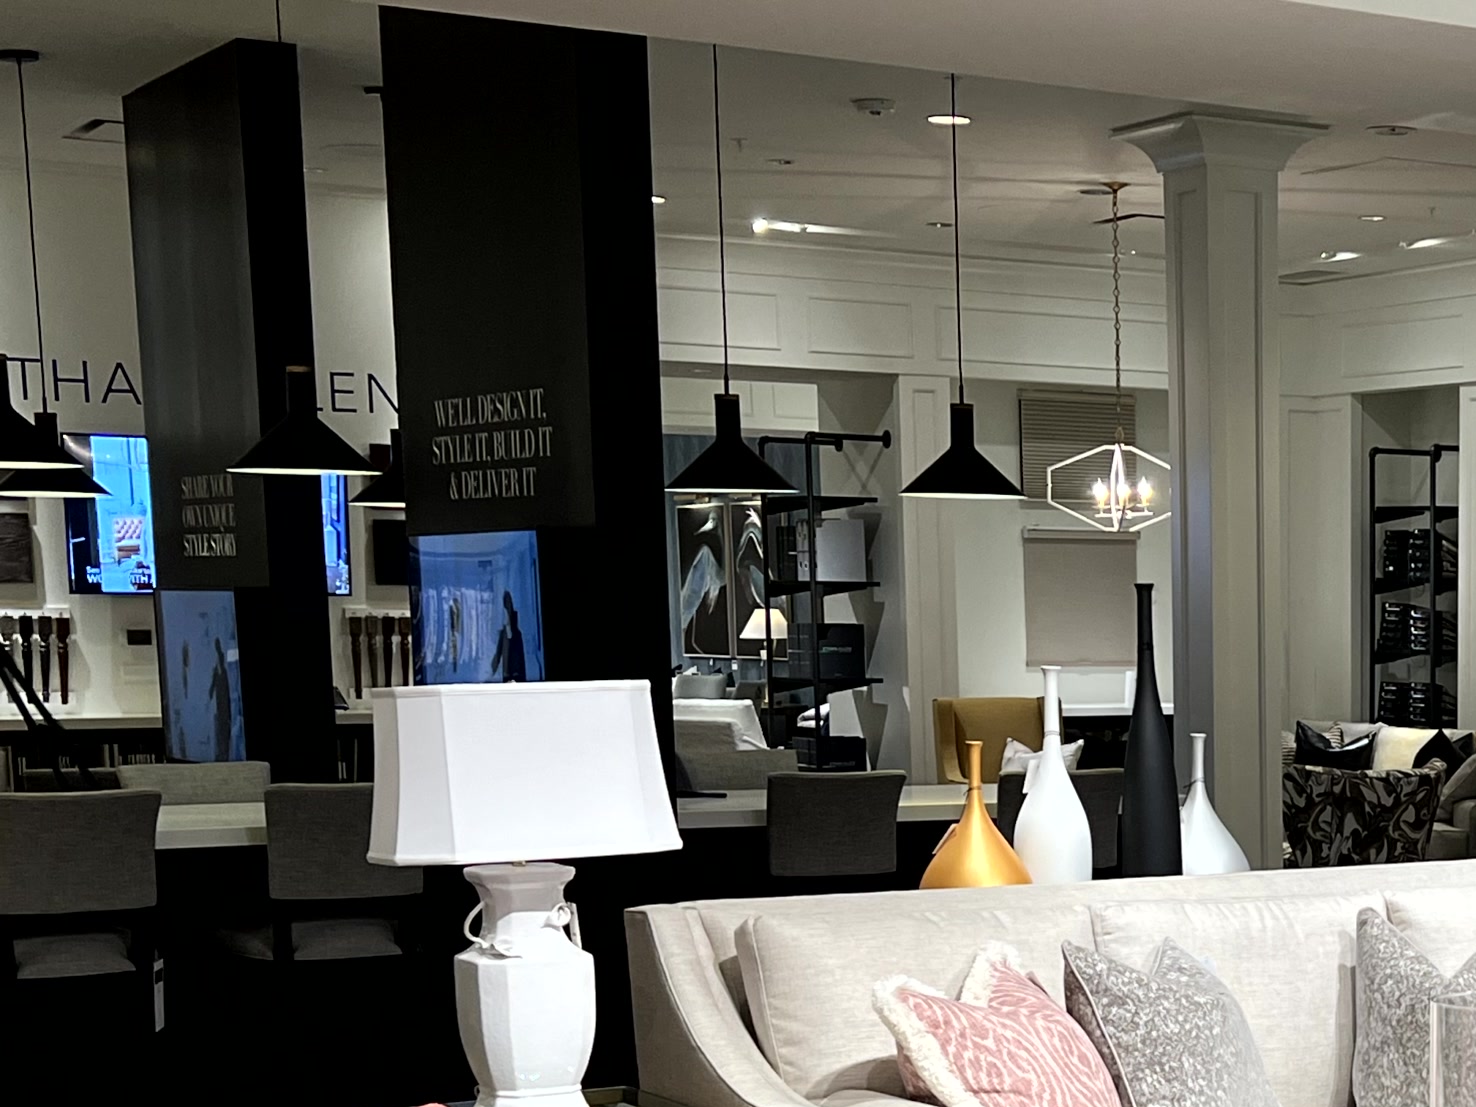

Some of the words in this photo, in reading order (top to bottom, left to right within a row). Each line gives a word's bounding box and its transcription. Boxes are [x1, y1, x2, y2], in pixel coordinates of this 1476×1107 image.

[316, 371, 399, 414] EN
[434, 397, 476, 428] WE'LL
[478, 390, 526, 424] DESIGN
[529, 388, 547, 420] IT,
[432, 433, 473, 465] STYLE
[475, 432, 491, 463] IT,
[493, 428, 535, 460] BUILD
[538, 426, 553, 457] IT
[181, 475, 209, 499] SHARE
[210, 473, 234, 497] YOUR
[450, 471, 459, 500] &
[461, 468, 520, 499] DELIVER
[522, 467, 537, 496] IT
[182, 505, 203, 528] OWN
[203, 503, 236, 532] UNIQUE
[183, 533, 210, 557] STYLE
[211, 533, 237, 557] STORY
